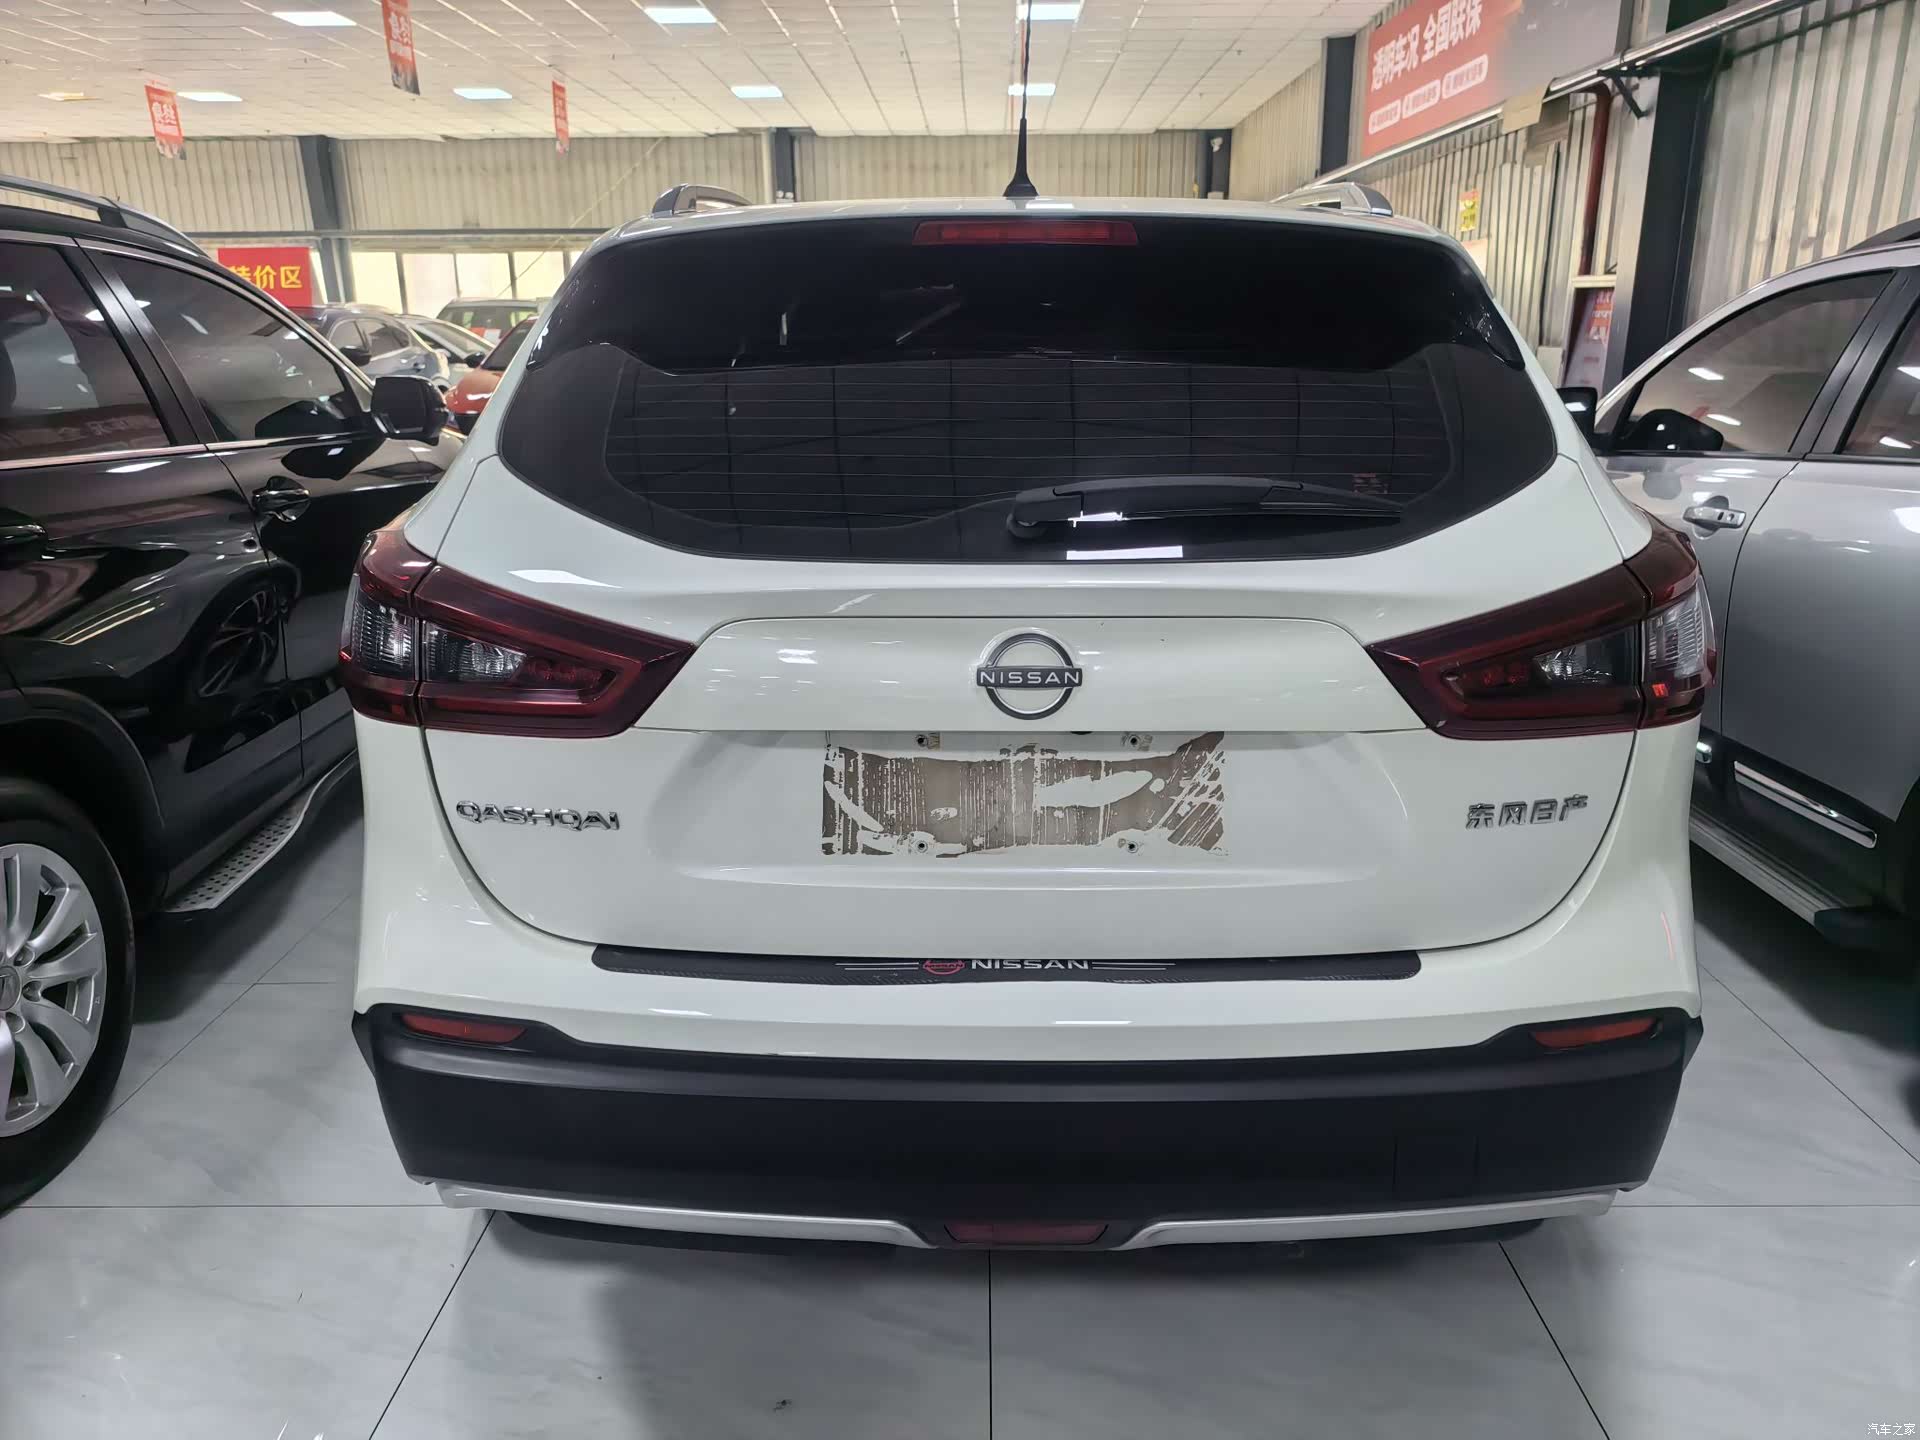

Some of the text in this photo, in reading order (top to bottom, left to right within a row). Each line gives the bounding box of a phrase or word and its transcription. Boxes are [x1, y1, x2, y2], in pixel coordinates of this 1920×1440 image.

[980, 671, 1079, 684] NISSAN
[456, 800, 620, 831] QASHQAI
[1465, 794, 1589, 829] 东风日产
[971, 959, 1088, 970] NISSAN
